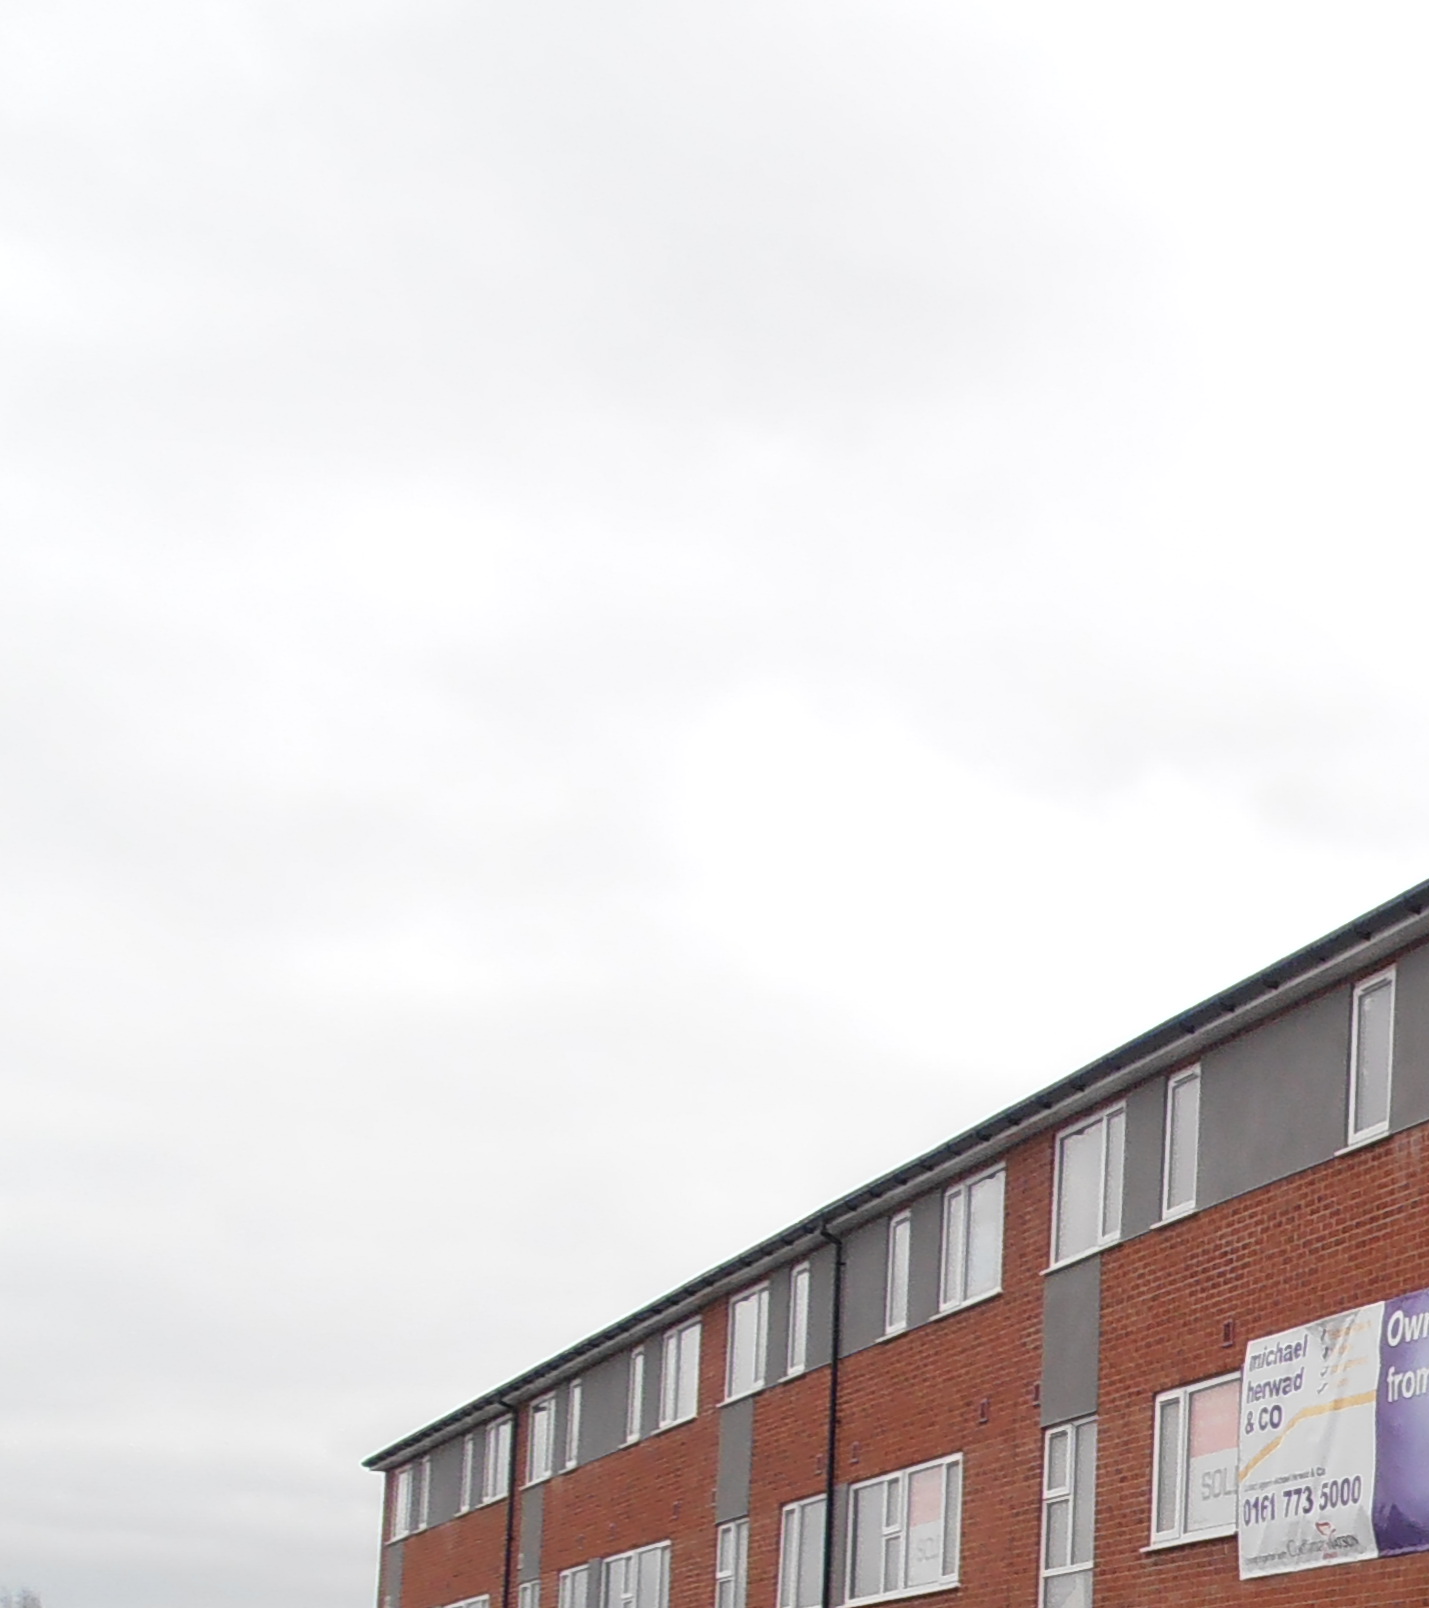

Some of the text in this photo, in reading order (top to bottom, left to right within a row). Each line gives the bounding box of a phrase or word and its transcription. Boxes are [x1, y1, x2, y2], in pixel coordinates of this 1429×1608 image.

[1249, 1334, 1309, 1373] michael
[1245, 1414, 1255, 1435] &
[1243, 1492, 1276, 1526] 0161
[1283, 1486, 1314, 1518] 773
[1319, 1475, 1362, 1511] 5000
